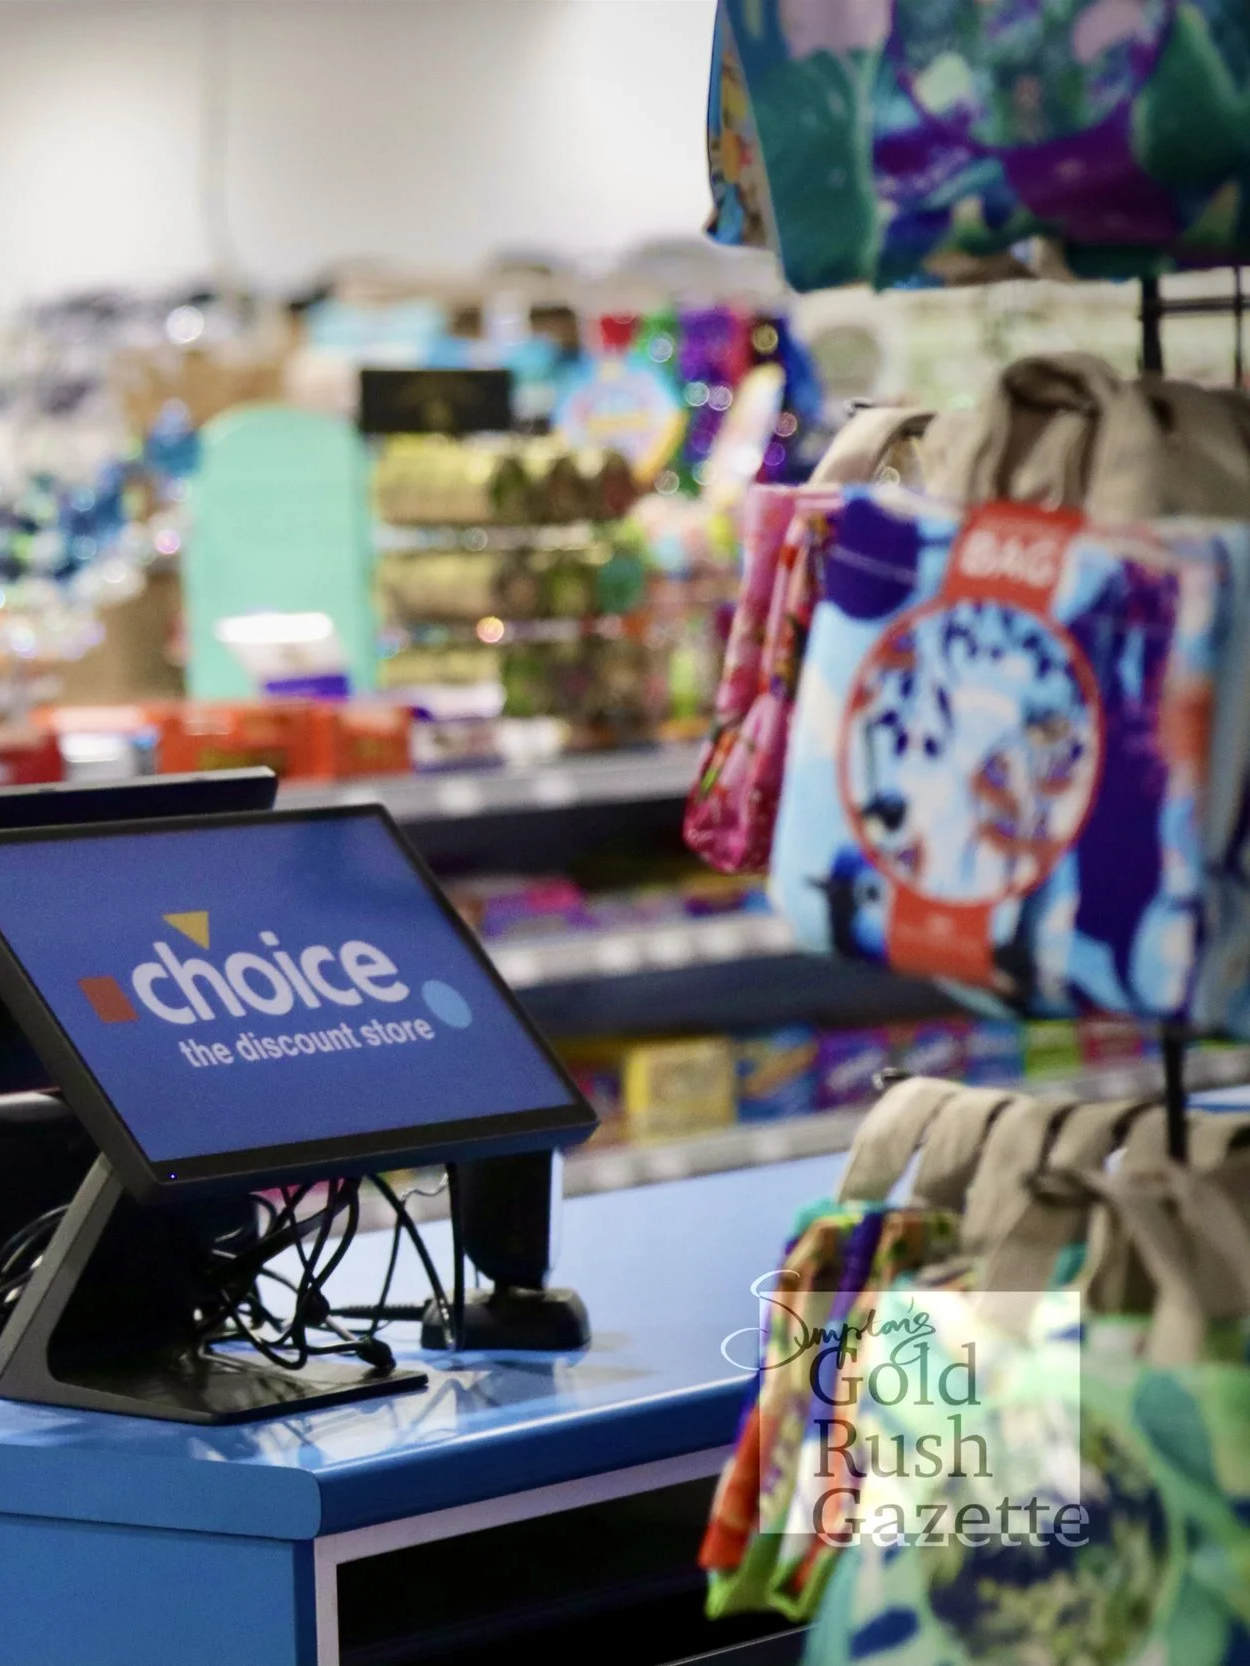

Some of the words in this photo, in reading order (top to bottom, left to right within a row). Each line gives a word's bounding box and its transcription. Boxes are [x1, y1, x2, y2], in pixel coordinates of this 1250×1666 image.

[131, 931, 411, 1025] choice
[178, 1038, 235, 1068] the
[236, 1022, 362, 1063] discount
[360, 1017, 437, 1047] store
